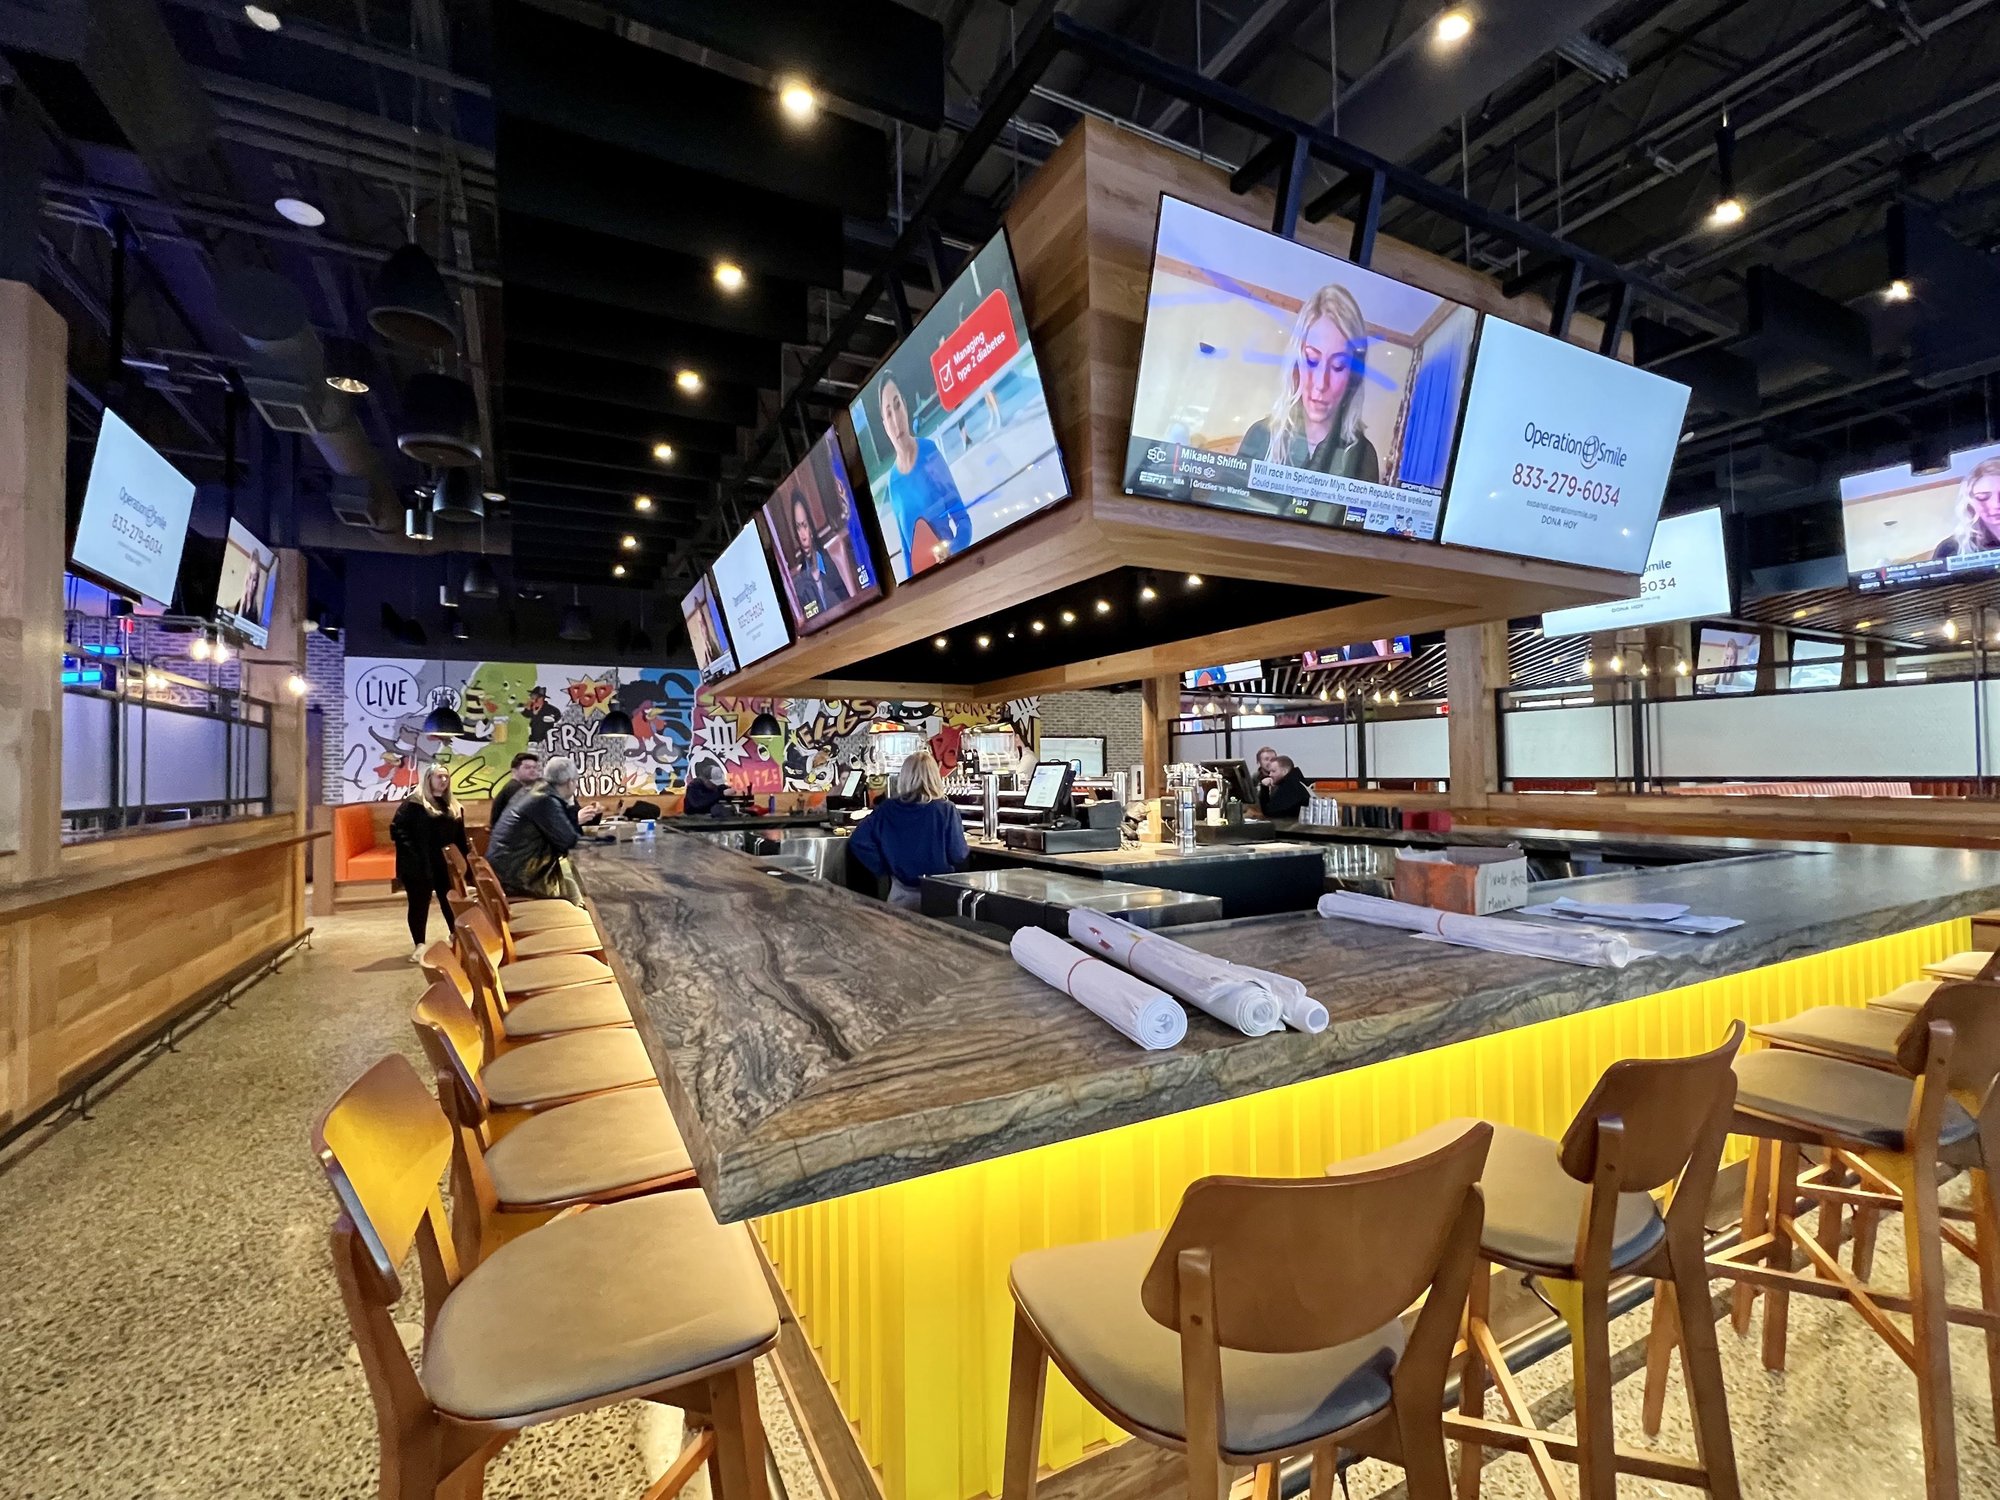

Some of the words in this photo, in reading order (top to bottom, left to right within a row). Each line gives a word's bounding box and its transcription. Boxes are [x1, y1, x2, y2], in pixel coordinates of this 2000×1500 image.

[953, 331, 985, 366] Managing
[957, 365, 972, 382] type
[970, 355, 977, 367] 2
[976, 331, 1006, 362] diabetes
[1524, 421, 1582, 456] Operation
[1597, 442, 1628, 467] Smile
[1179, 461, 1202, 475] Joins
[1181, 447, 1215, 465] Mikaela
[1216, 455, 1248, 471] Shiffrin
[1139, 471, 1167, 485] ESPN
[1251, 476, 1269, 487] Could
[1254, 463, 1267, 474] Will
[1268, 468, 1284, 479] race
[1285, 469, 1292, 480] in
[1348, 482, 1368, 495] Czech
[1368, 486, 1396, 500] Republic
[1395, 492, 1407, 502] this
[1407, 494, 1433, 507] weekend
[1512, 462, 1621, 507] 833-279-6034
[111, 512, 164, 556] 833-279-6034
[1563, 518, 1579, 530] HOY
[1640, 577, 1677, 593] 6034
[366, 679, 408, 707] LIVE
[547, 720, 600, 752] FRY
[551, 749, 608, 775] UT
[573, 768, 626, 797] UD!
